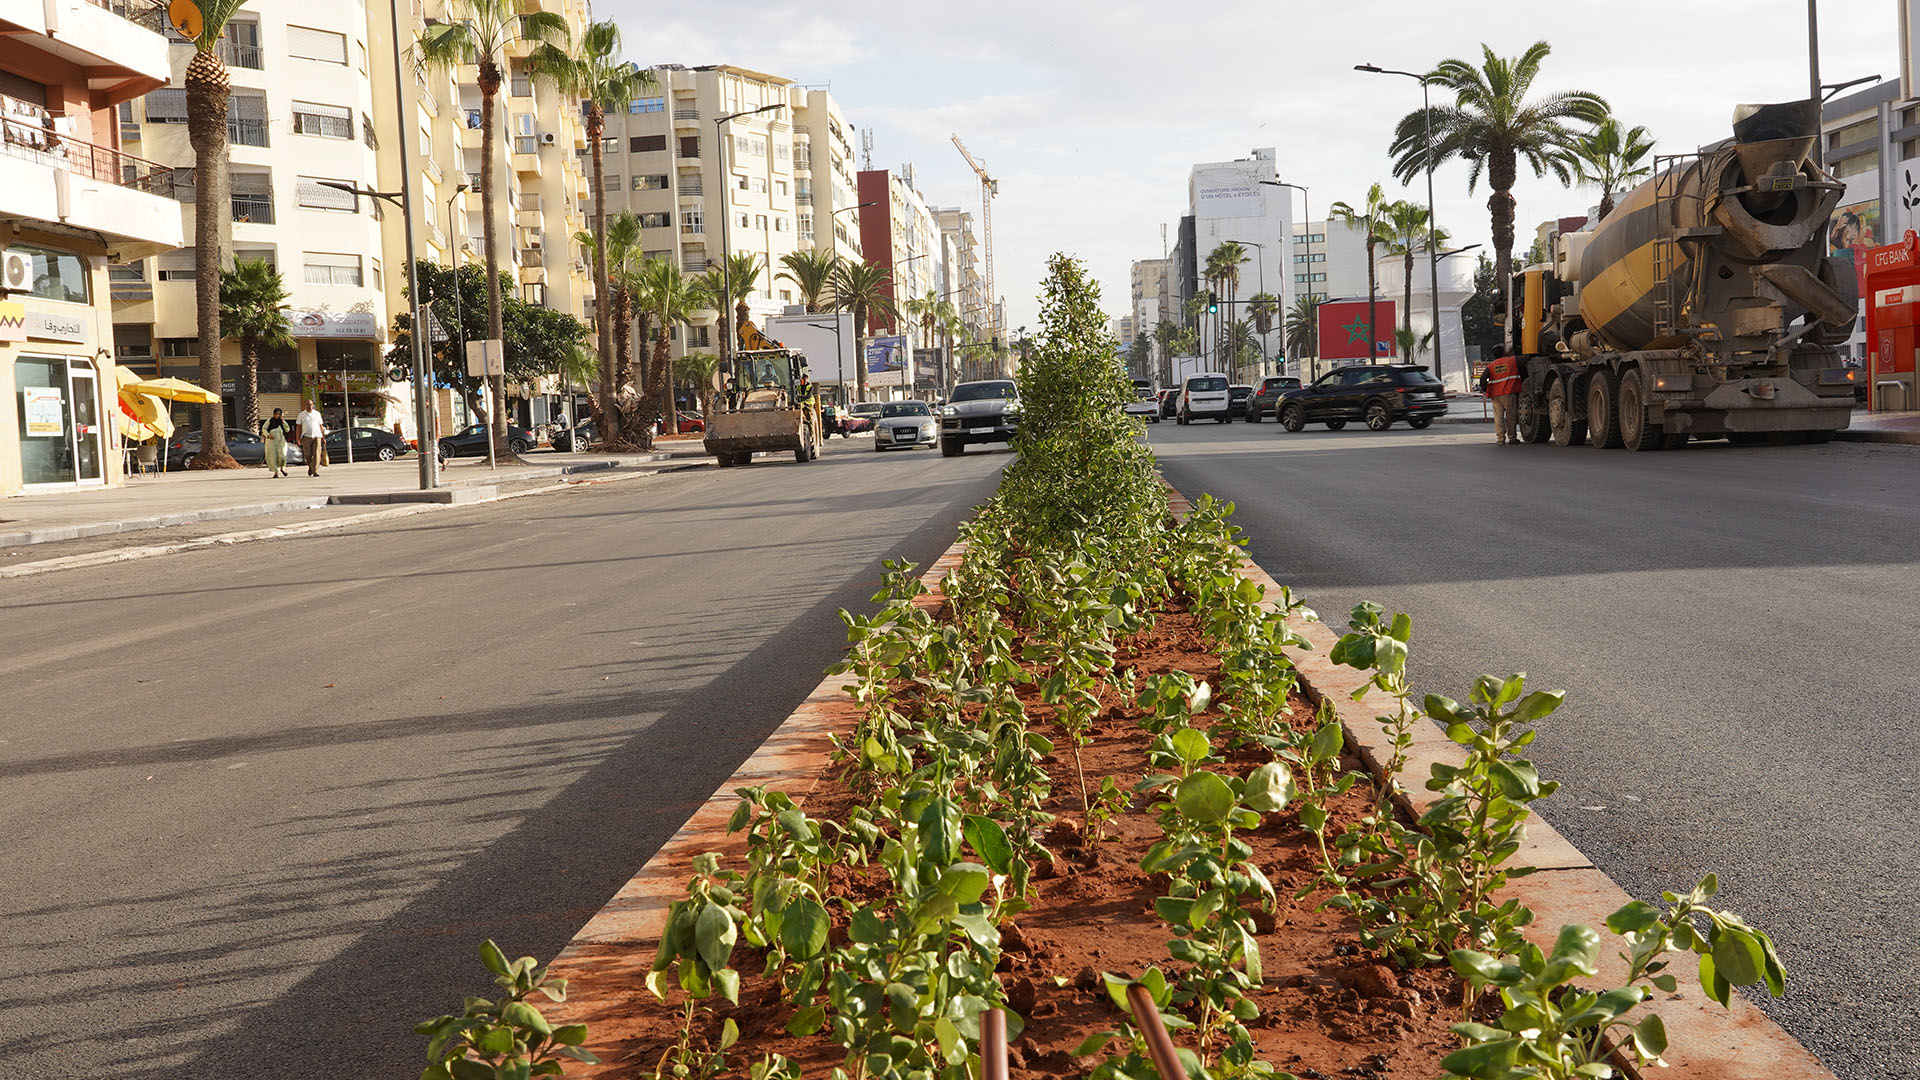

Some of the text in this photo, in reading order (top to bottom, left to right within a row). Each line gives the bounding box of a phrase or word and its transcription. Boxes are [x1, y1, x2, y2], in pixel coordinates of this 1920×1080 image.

[1875, 248, 1909, 267] CFG BANK
[44, 319, 57, 334] وفا
